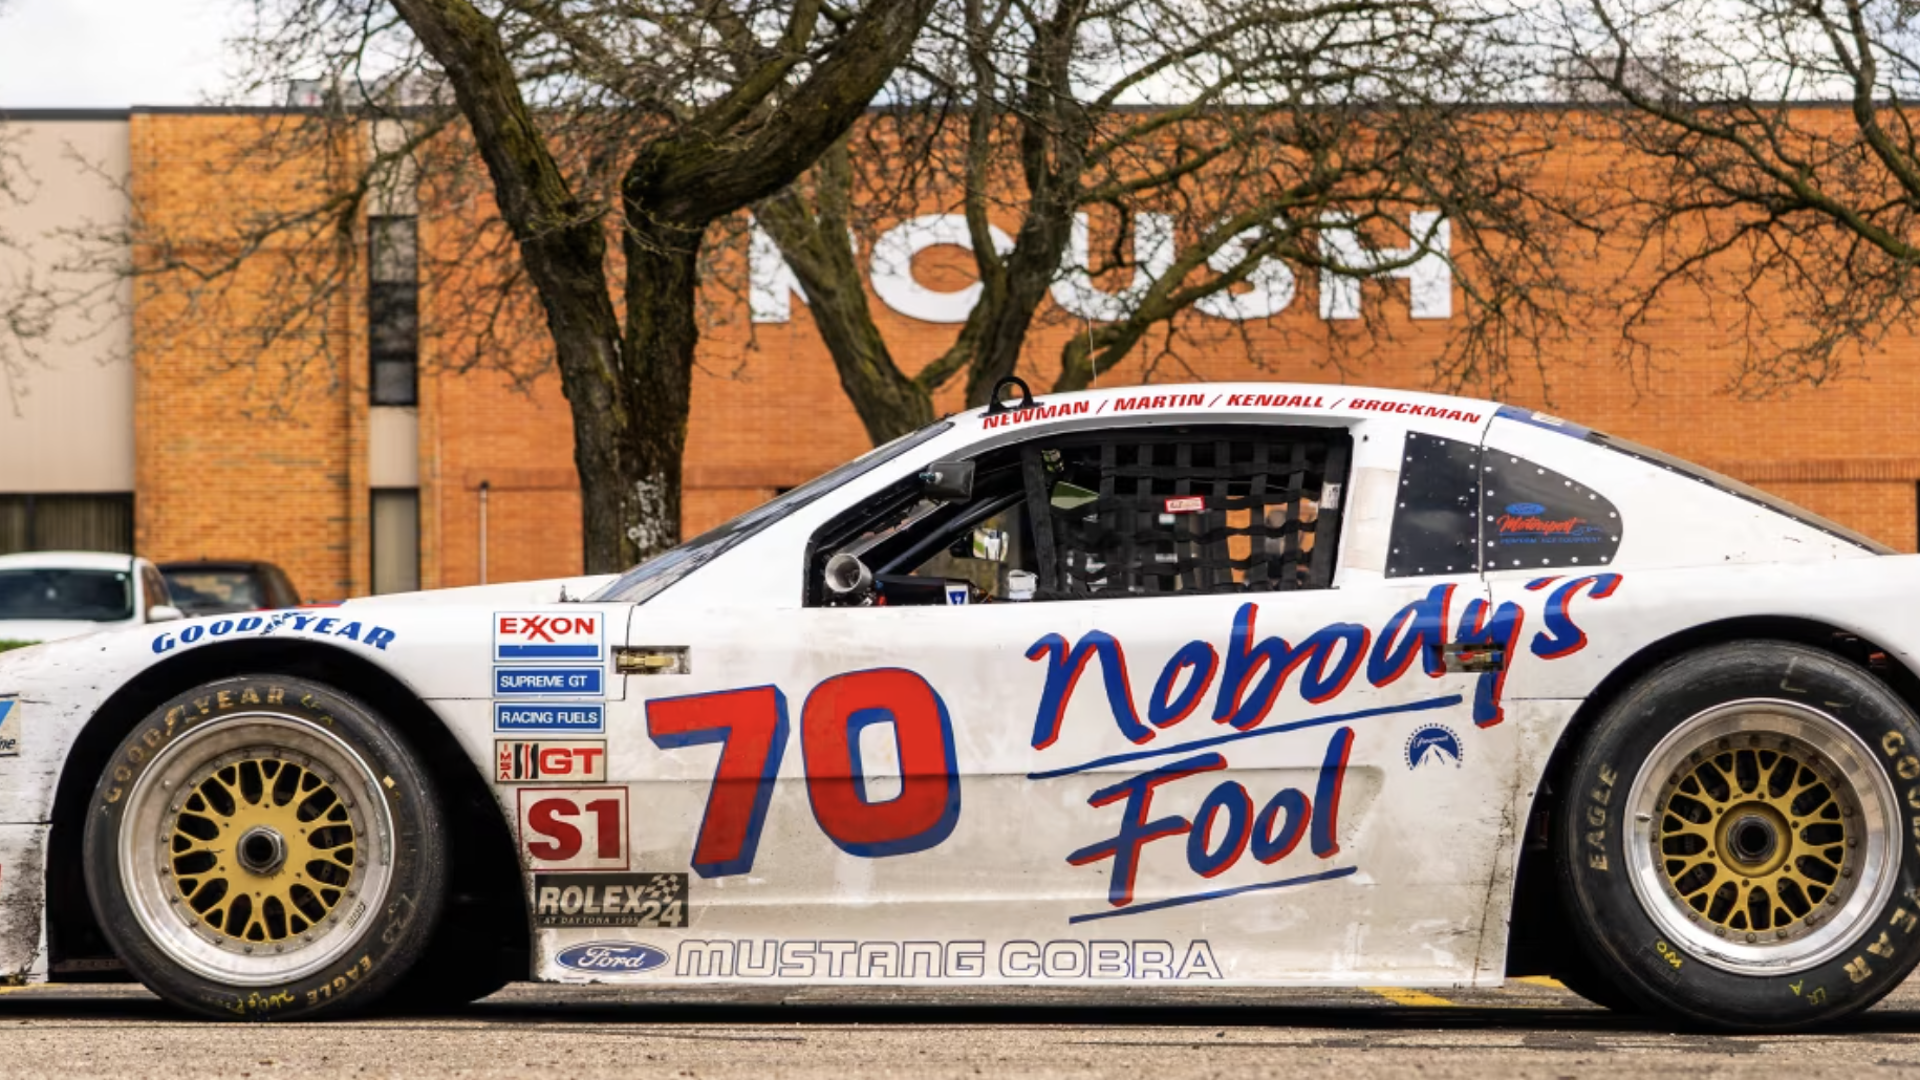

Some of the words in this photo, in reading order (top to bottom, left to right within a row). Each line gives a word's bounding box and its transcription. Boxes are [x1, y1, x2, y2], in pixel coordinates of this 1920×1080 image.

[983, 401, 1090, 430] NEWMAN
[1114, 393, 1205, 411] MARTIN
[1226, 394, 1324, 408] KENDALL
[1348, 398, 1482, 424] BROCKMAN
[152, 612, 396, 654] GOODYEAR
[500, 615, 595, 643] EXXON
[500, 675, 564, 688] SUPREME
[568, 675, 588, 688] GT
[501, 711, 554, 724] RACING
[557, 711, 598, 724] FUELS
[103, 685, 286, 804] GOODYEAR
[500, 743, 513, 780] IMSA
[539, 748, 603, 775] GT
[645, 667, 961, 878] 70
[527, 797, 621, 861] S1
[1066, 726, 1355, 907] Fool
[1590, 765, 1619, 872] EAGLE
[538, 885, 648, 915] ROLEX
[637, 899, 683, 928] 24
[561, 916, 610, 925] DAYTONA
[577, 946, 647, 968] Ford
[675, 939, 986, 978] MUSTANG
[999, 940, 1224, 980] COBRA
[306, 954, 373, 1004] EAGLE
